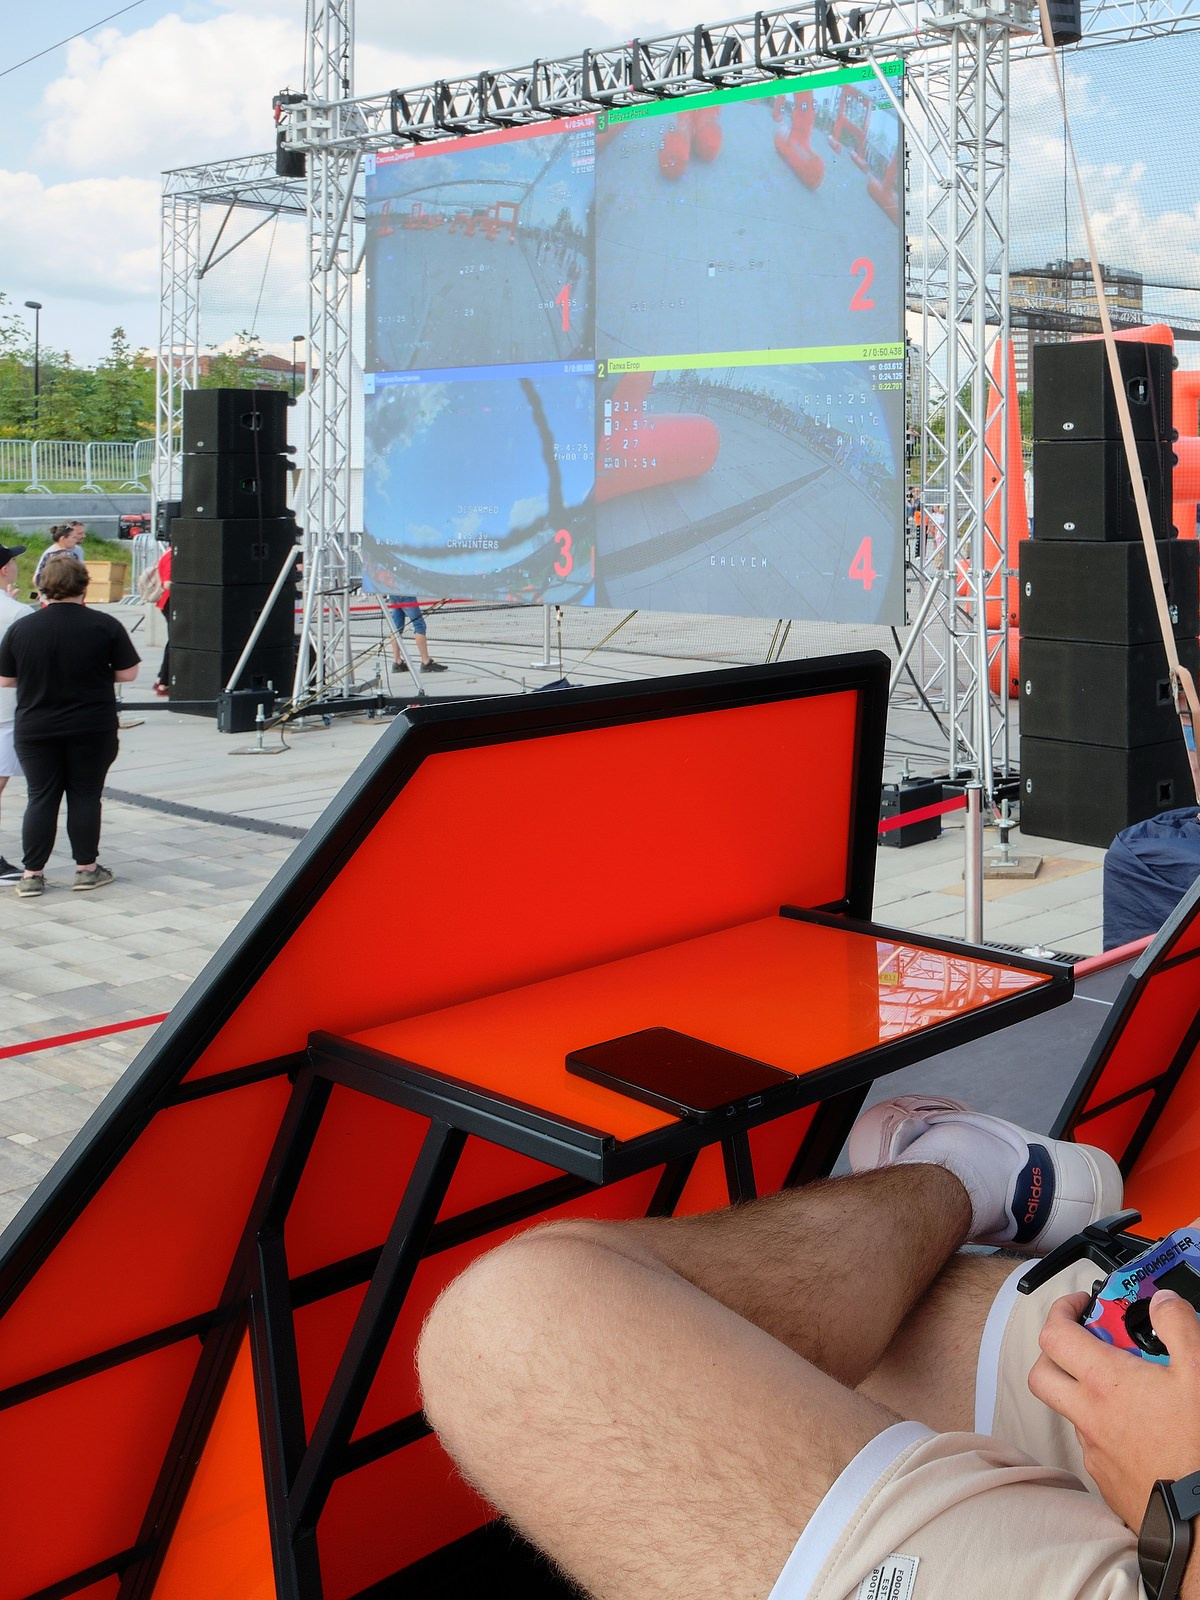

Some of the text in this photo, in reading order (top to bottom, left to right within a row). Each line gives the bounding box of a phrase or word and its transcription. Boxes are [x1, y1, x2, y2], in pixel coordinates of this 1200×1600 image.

[598, 115, 605, 130] 3
[850, 257, 875, 311] 2
[555, 284, 570, 333] 1
[598, 363, 605, 378] 2
[447, 539, 499, 550] CRYWINTERS
[553, 529, 573, 577] 3
[848, 536, 876, 591] 4
[1024, 1167, 1042, 1224] adidas
[1121, 1236, 1195, 1291] RADIOMASTER
[866, 1569, 880, 1600] BOOTS
